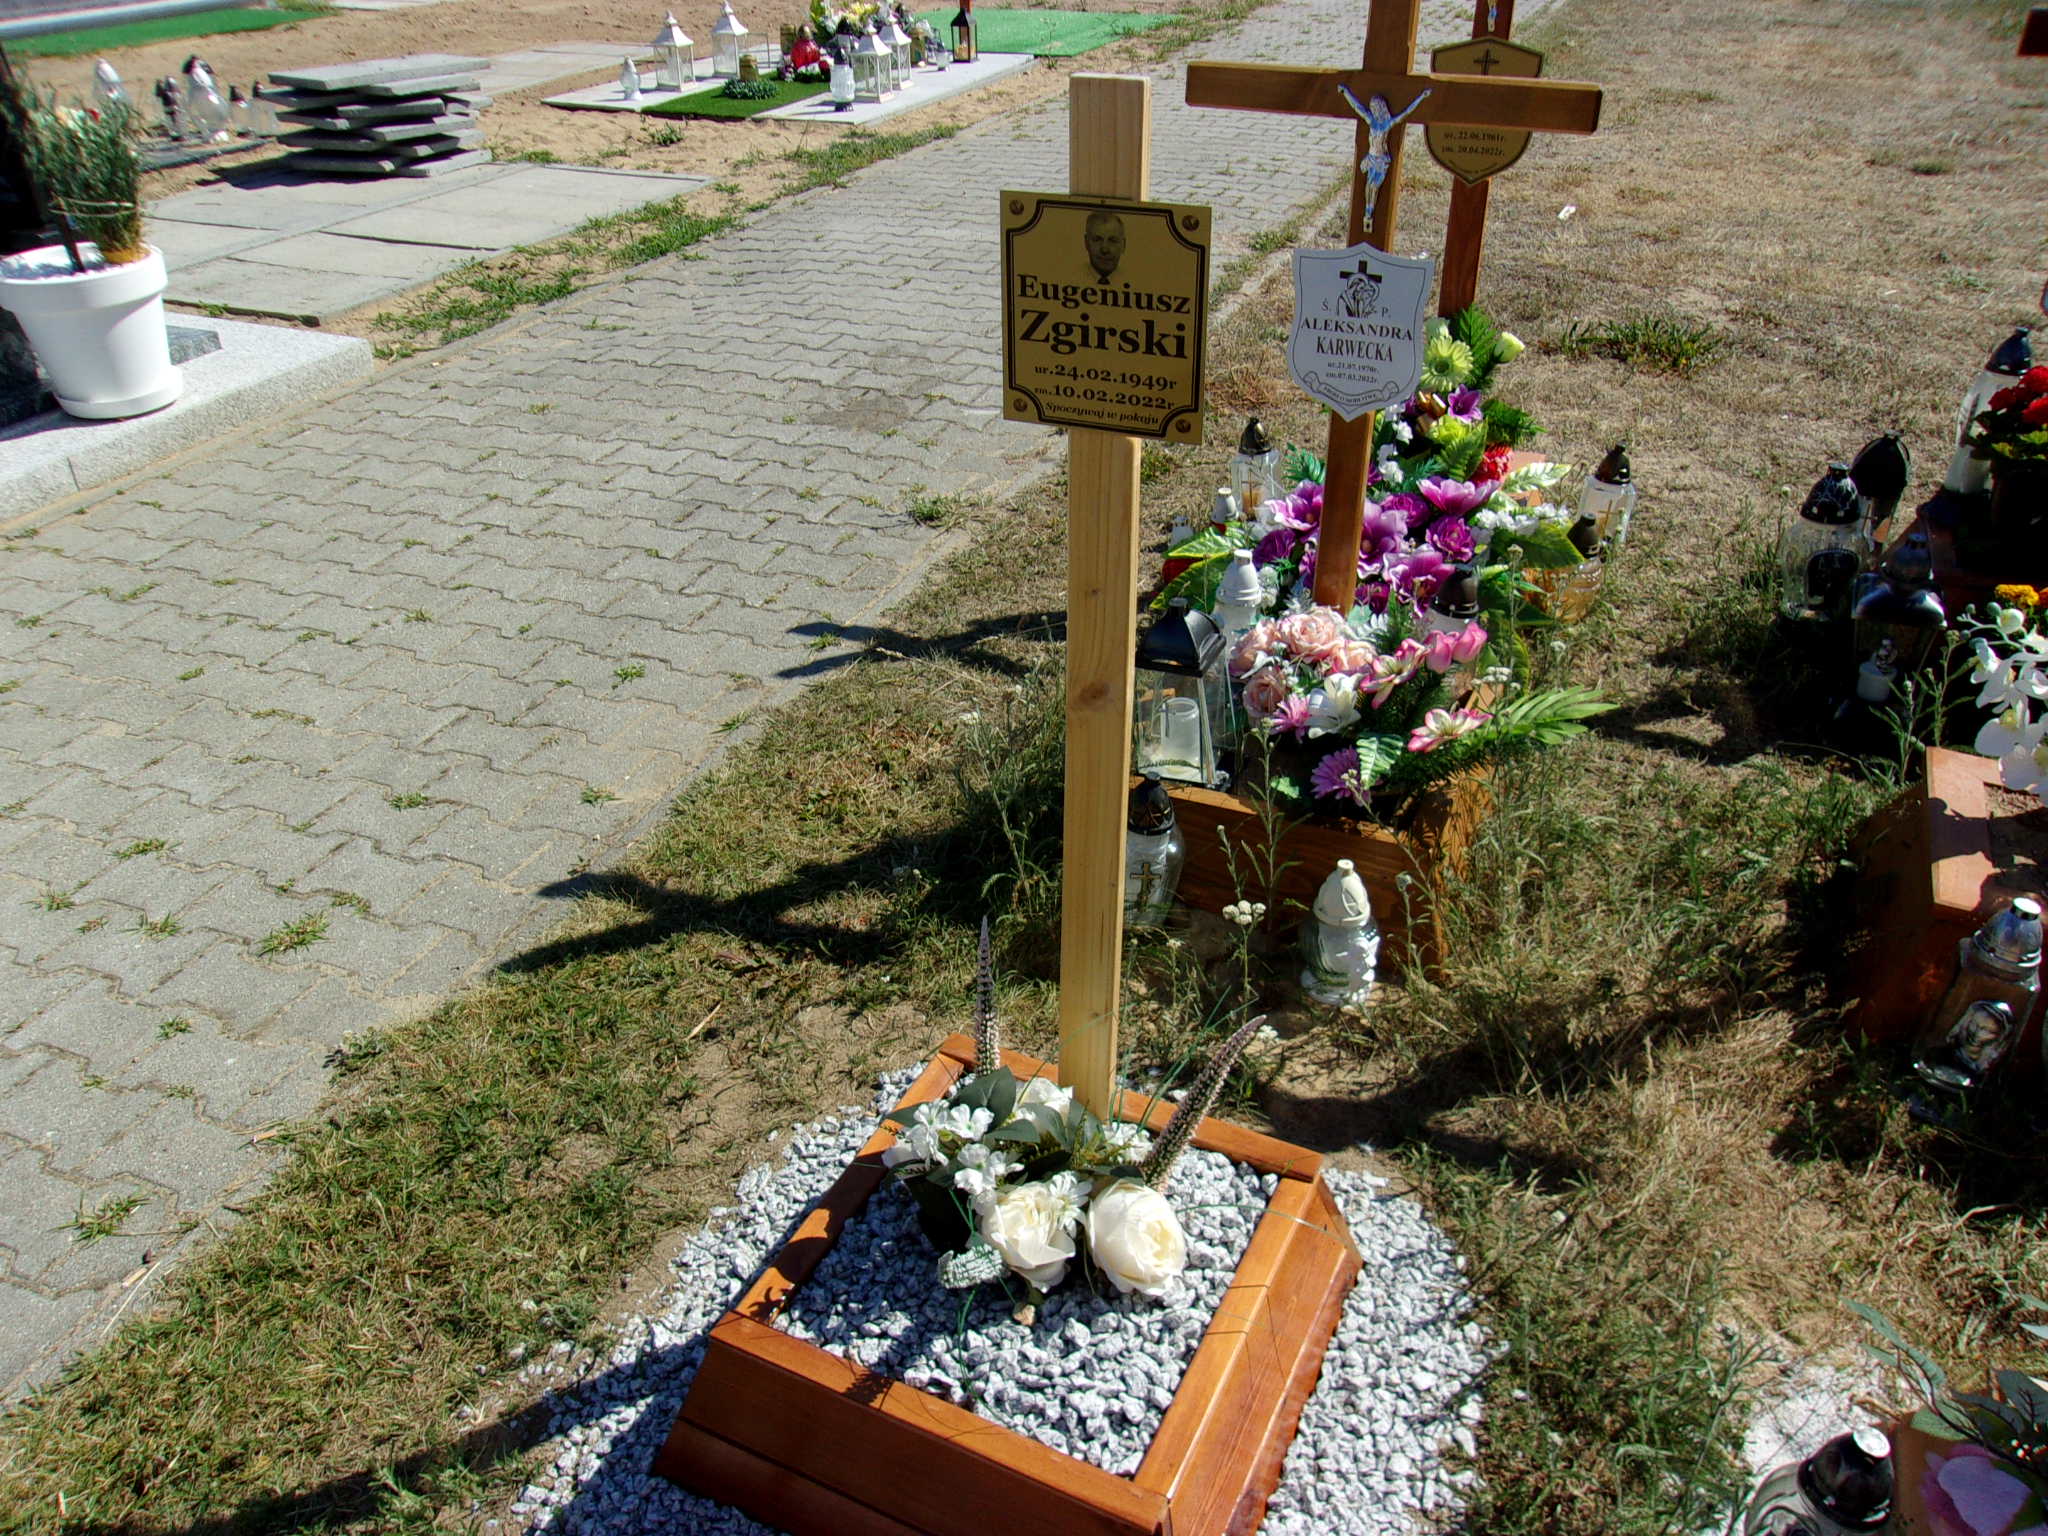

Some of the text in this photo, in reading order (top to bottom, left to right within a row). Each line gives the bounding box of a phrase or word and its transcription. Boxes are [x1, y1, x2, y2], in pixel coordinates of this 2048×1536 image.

[1016, 273, 1191, 315] Eugeniusz
[1019, 308, 1188, 359] Zgirski
[1301, 316, 1413, 341] ALEKSANDRA
[1316, 335, 1393, 362] KARWECKA
[1034, 363, 1177, 391] ur.24.02.1949r
[1045, 400, 1159, 425] Spoczywaj w pokoju
